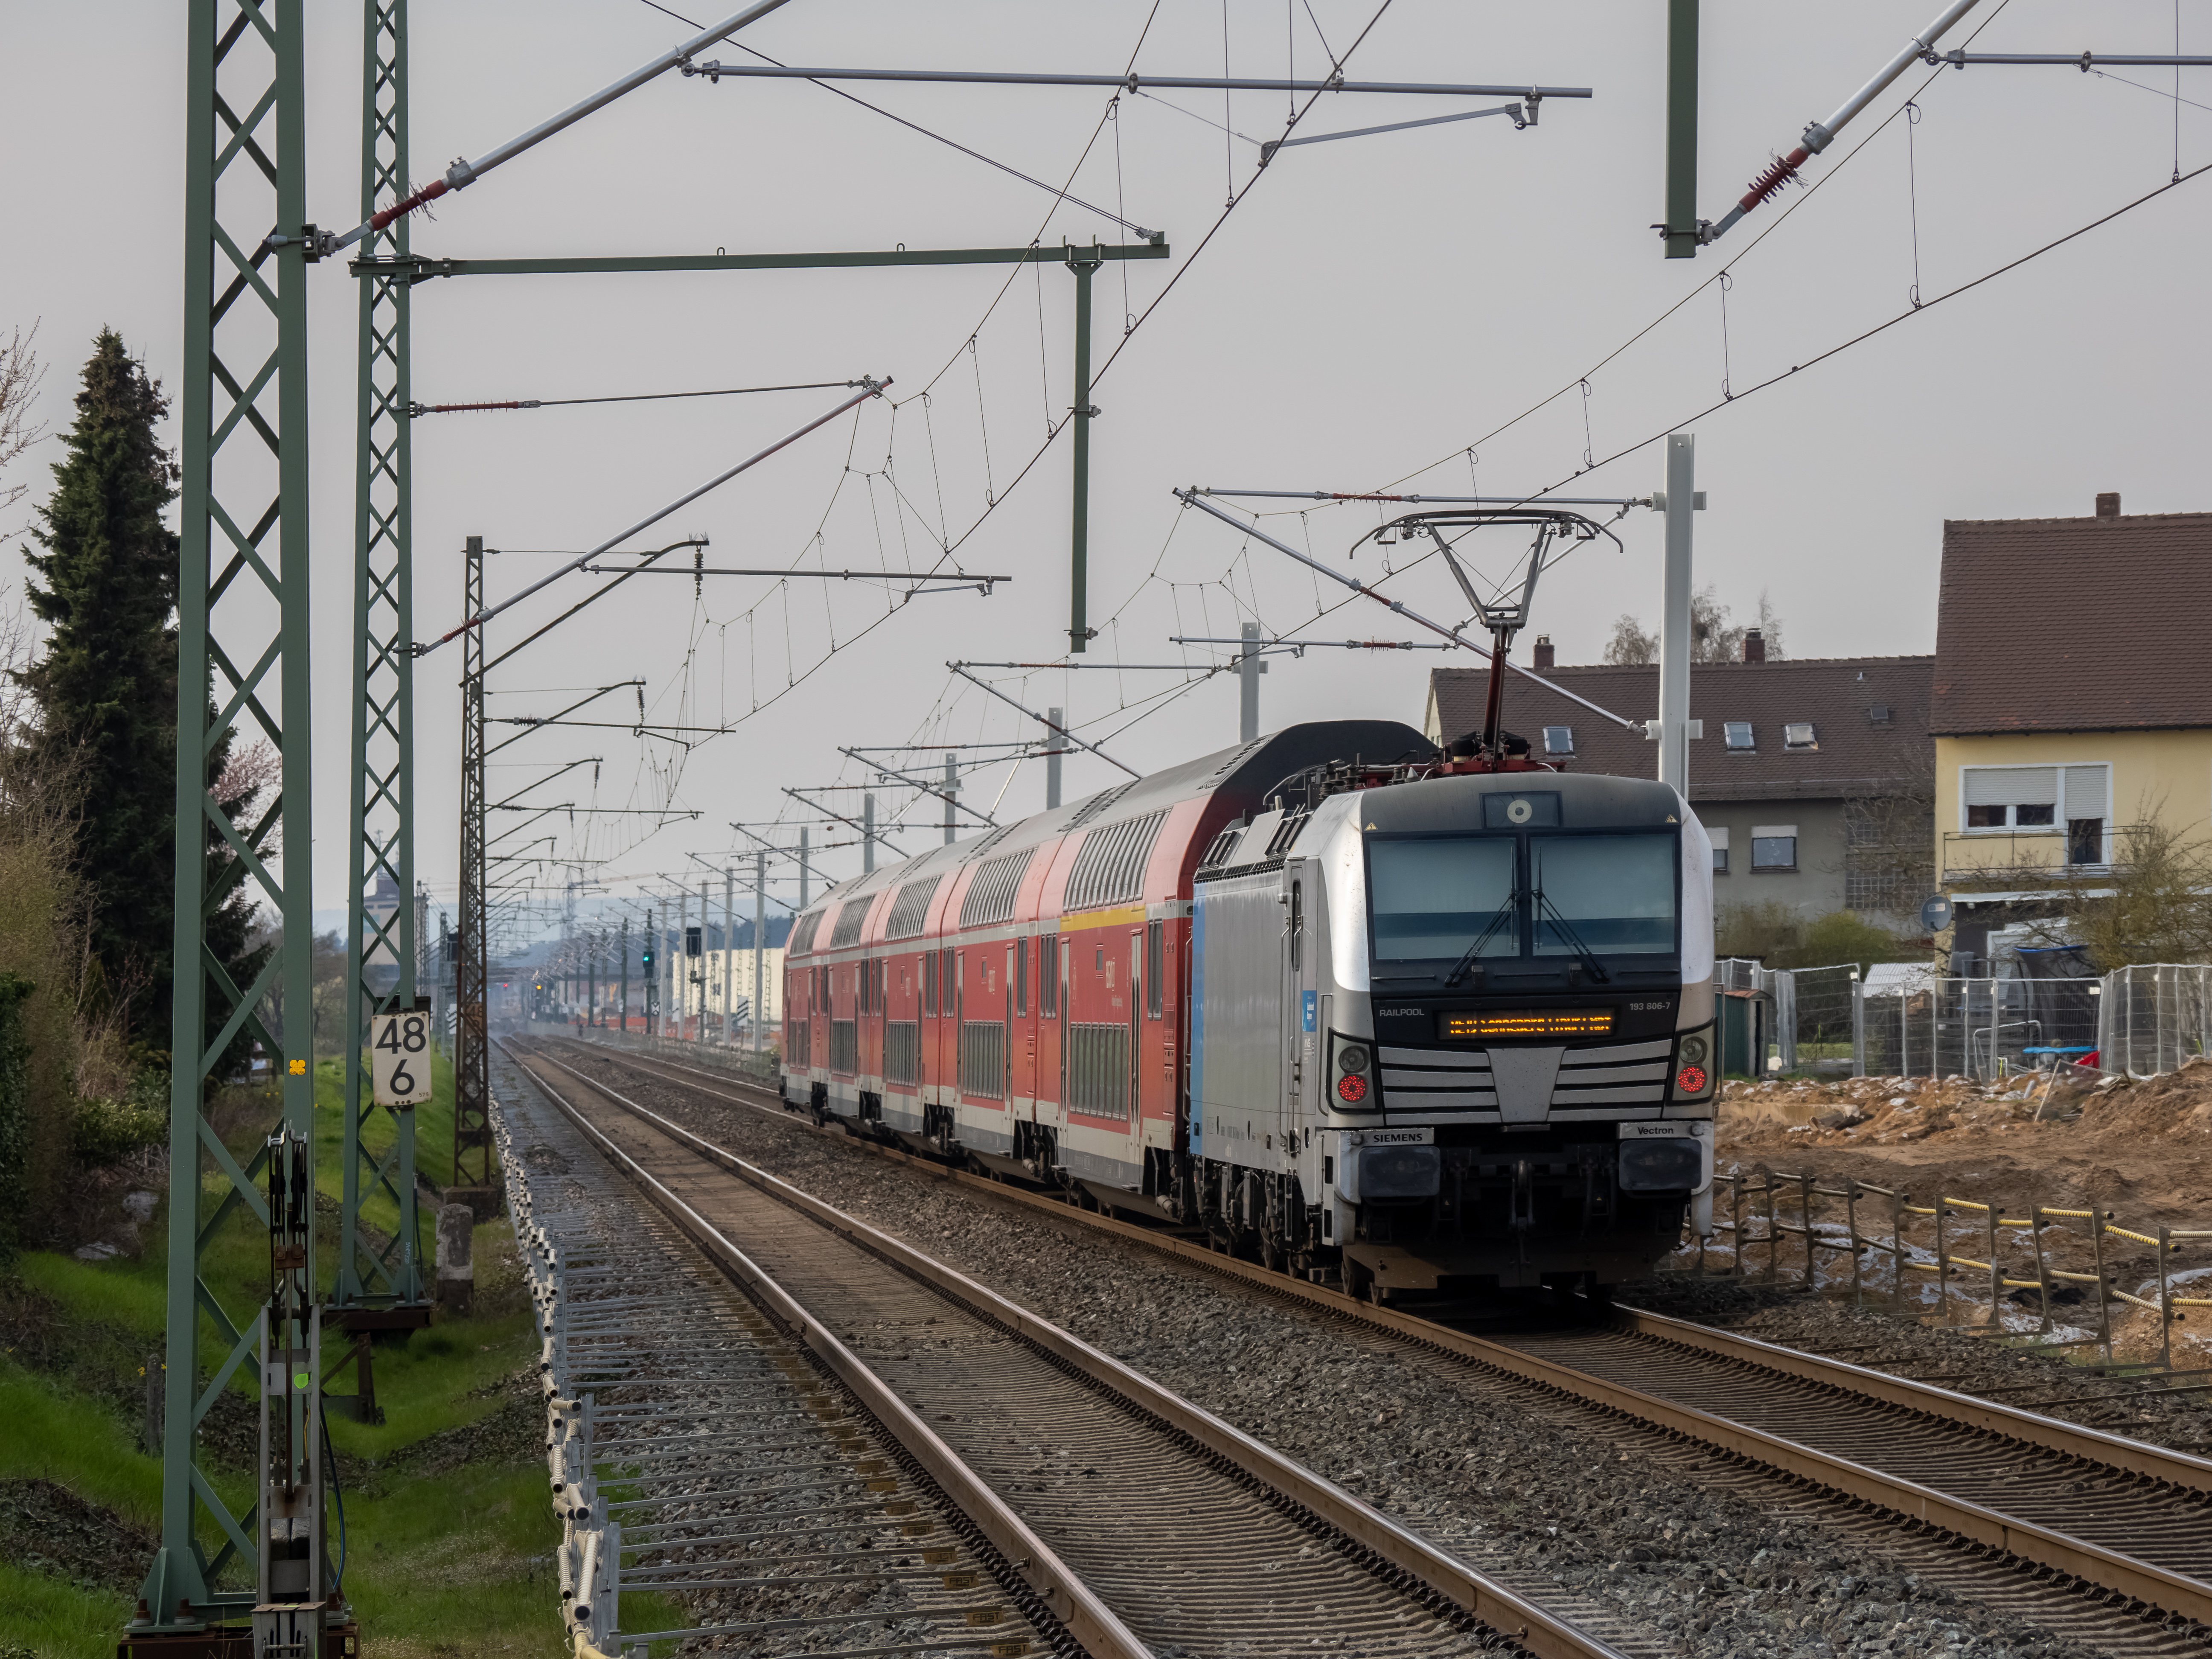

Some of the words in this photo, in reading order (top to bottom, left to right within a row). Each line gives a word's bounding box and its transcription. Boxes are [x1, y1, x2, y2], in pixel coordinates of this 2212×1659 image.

[1647, 1002, 1671, 1010] 806-7
[1380, 1008, 1425, 1016] RAILPOOL
[375, 1016, 426, 1054] 48
[390, 1059, 415, 1096] 6
[1638, 1127, 1674, 1135] Vectron
[1374, 1133, 1423, 1143] SIEMENS
